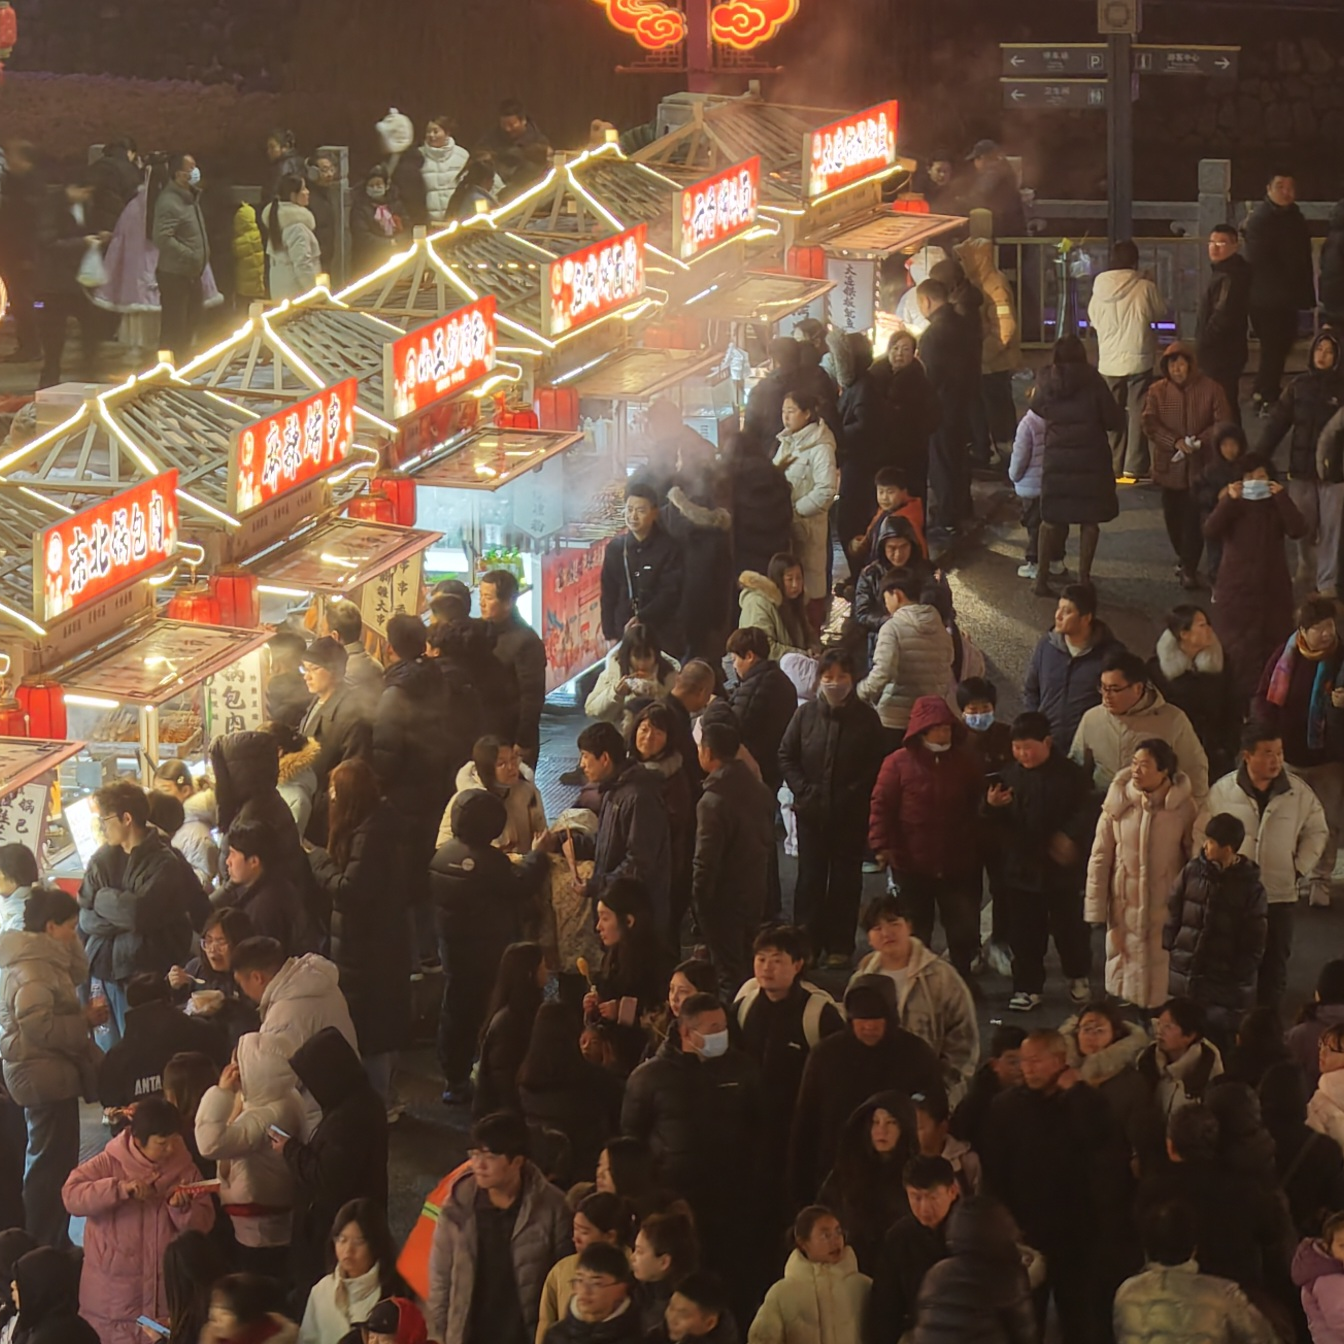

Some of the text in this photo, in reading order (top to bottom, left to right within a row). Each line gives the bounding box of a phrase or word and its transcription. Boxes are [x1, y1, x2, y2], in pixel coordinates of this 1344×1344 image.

[262, 392, 342, 493] 麻辣烤串
[67, 494, 163, 593] 东北锅包肉
[220, 661, 247, 734] 锅包肉
[134, 1073, 163, 1097] ANTA
